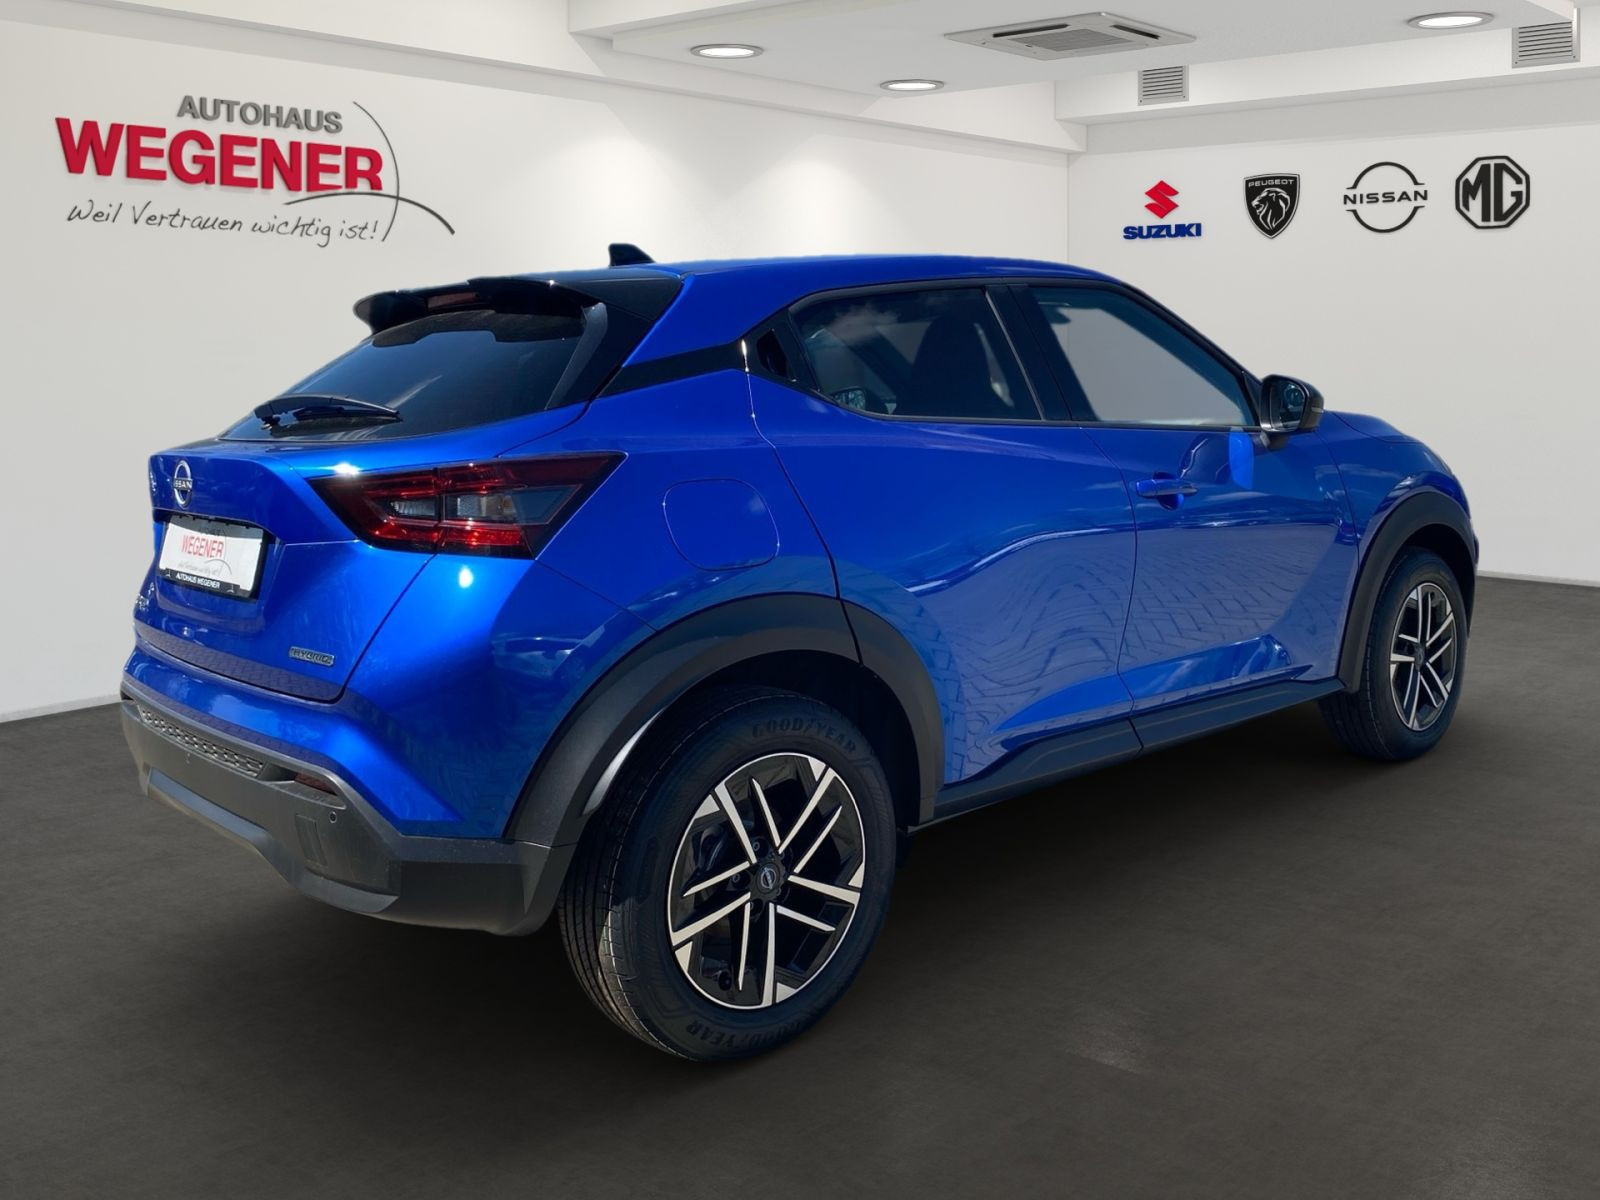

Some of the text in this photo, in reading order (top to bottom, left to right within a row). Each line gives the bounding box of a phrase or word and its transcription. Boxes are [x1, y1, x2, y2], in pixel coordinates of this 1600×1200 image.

[177, 95, 343, 133] AUTOHAUS
[55, 117, 383, 192] WEGENER
[1248, 178, 1295, 188] PEUGEOT
[1343, 189, 1429, 206] NISSAN
[1461, 162, 1524, 223] MG
[67, 199, 379, 248] Weil Vertrauen wichtig ist!
[1123, 223, 1202, 240] SUZUKI
[180, 534, 224, 559] WEGENER
[197, 577, 220, 589] WEGENER
[751, 717, 857, 753] GOODYEAR
